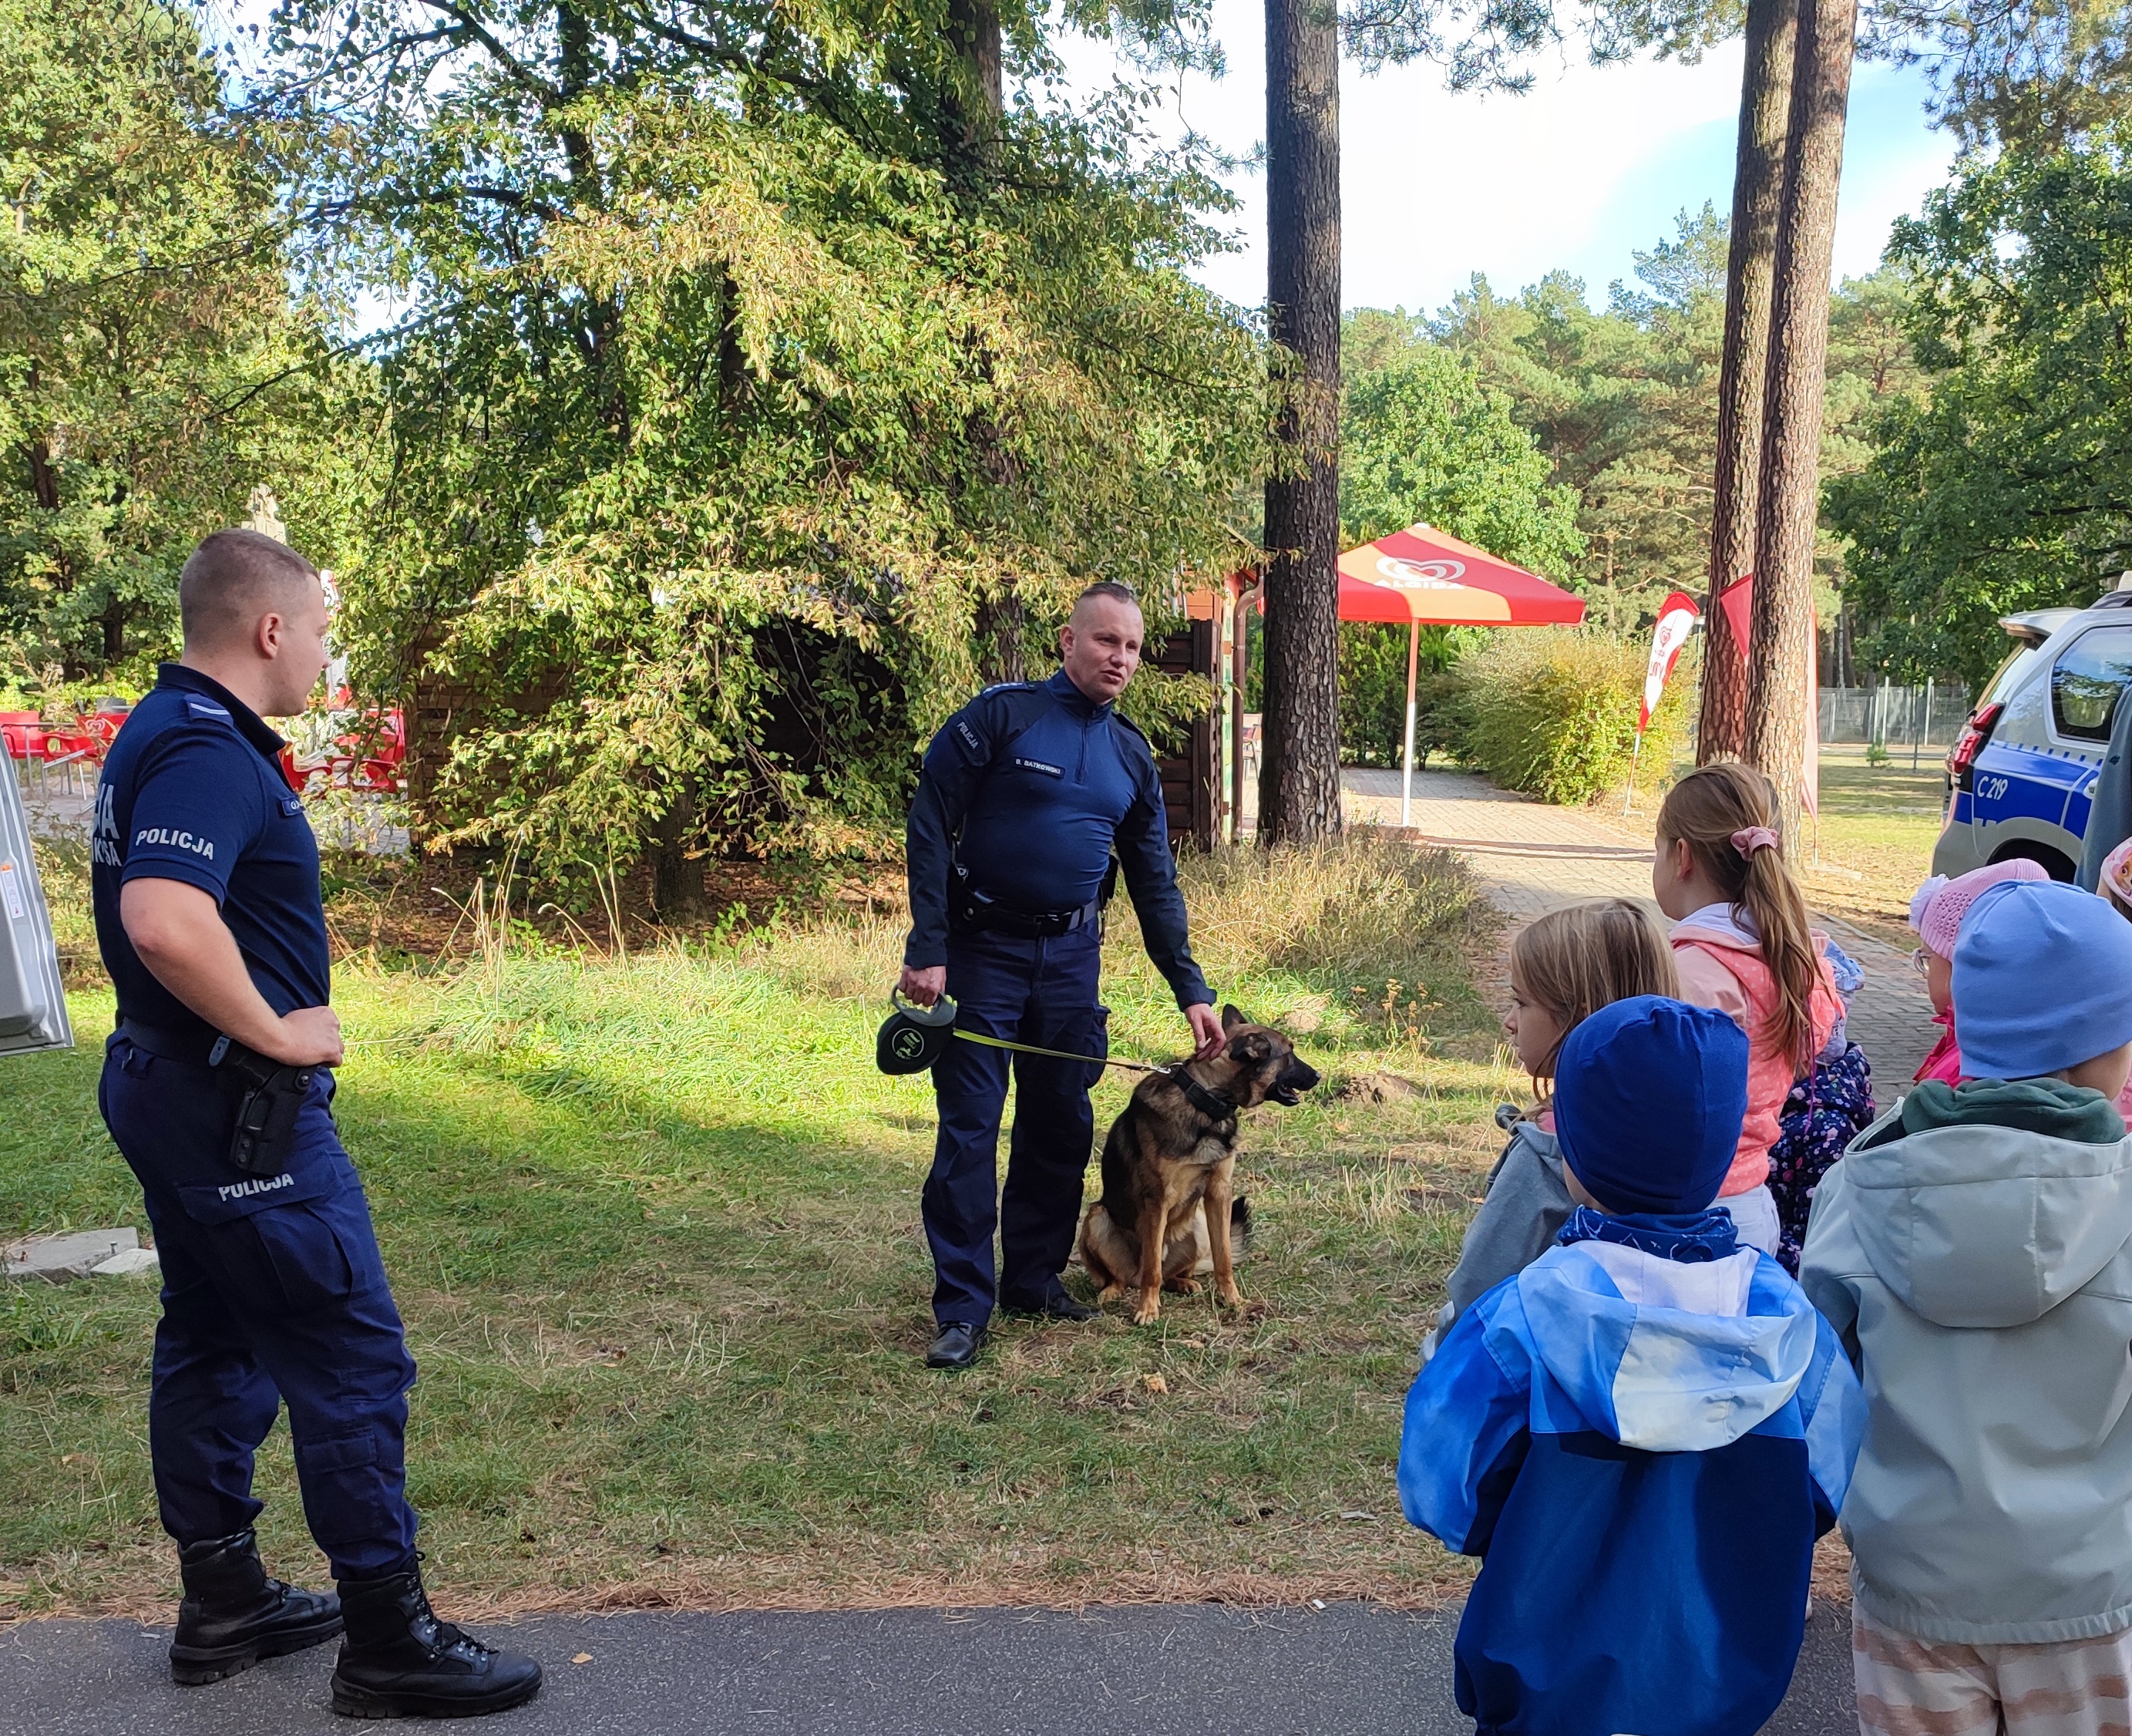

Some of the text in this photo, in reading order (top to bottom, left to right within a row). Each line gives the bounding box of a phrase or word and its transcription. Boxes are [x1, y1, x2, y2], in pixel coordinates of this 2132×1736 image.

[957, 721, 979, 749] POLICJA
[1977, 775, 2009, 800] C 219
[135, 828, 214, 861] POLICJA
[218, 1173, 294, 1202] POLICJA
